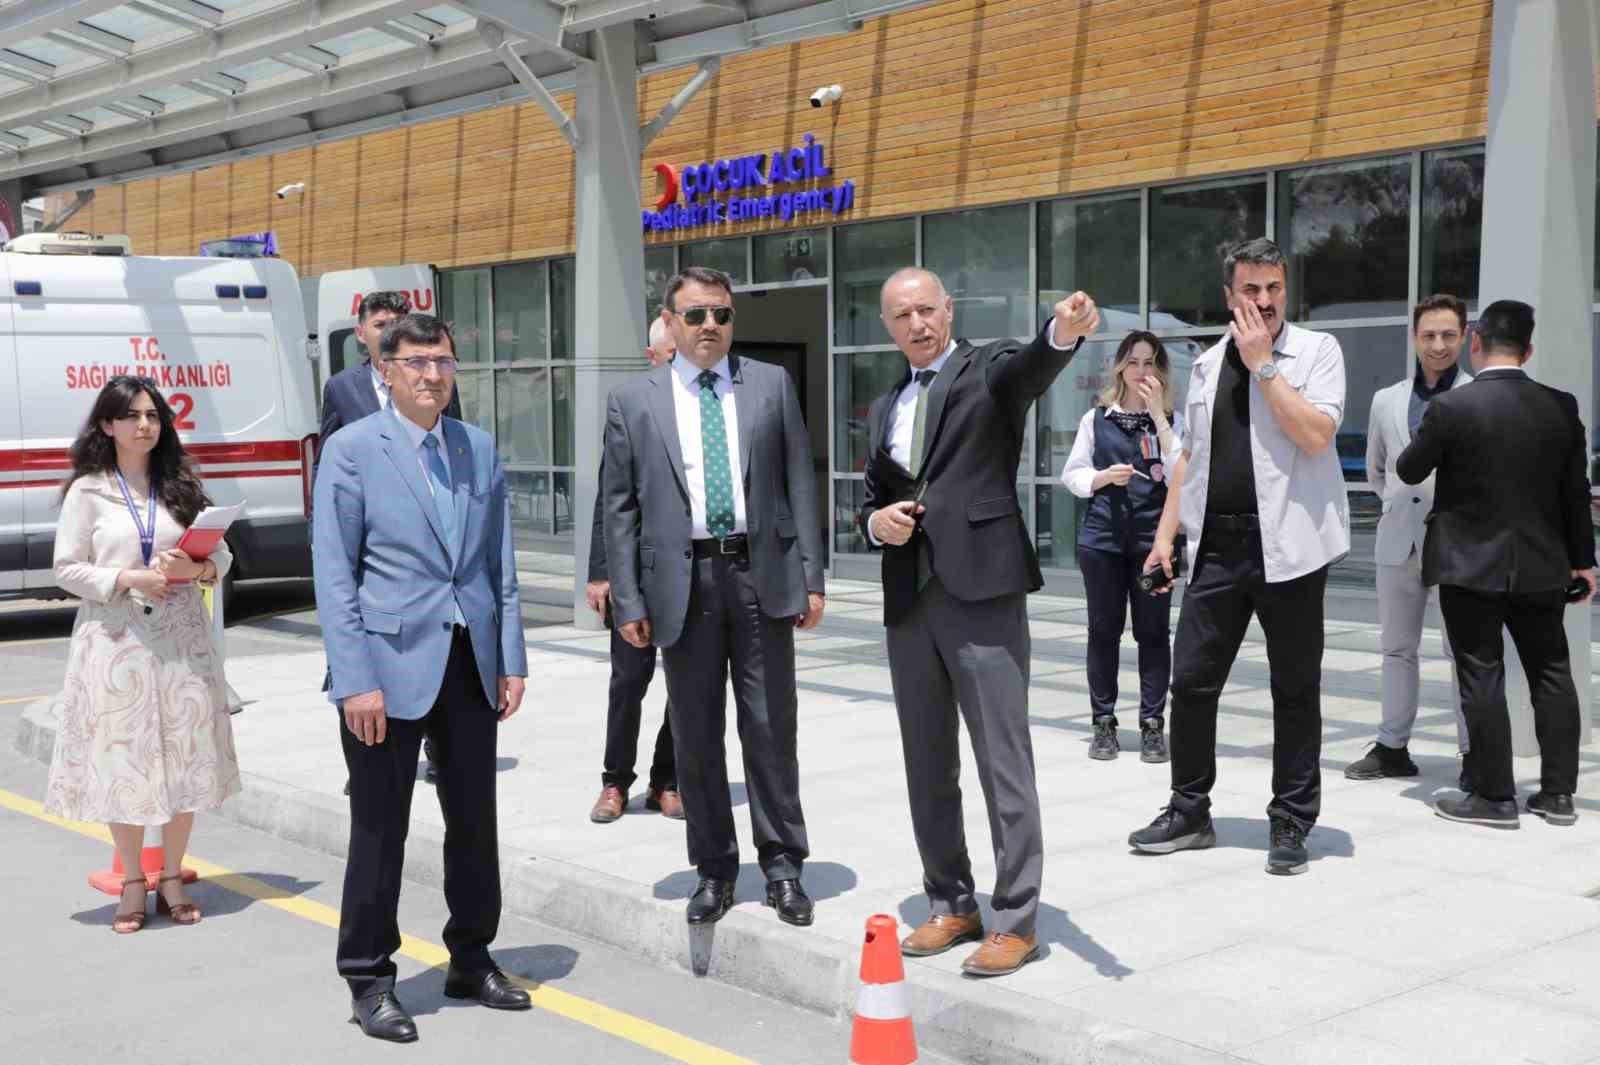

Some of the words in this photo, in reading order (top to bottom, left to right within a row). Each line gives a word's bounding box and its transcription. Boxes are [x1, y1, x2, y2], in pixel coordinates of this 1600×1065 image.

[681, 153, 767, 203] ÇOCUK
[767, 133, 832, 184] ACİL
[641, 199, 727, 233] Pediatric
[129, 336, 167, 361] T.C.
